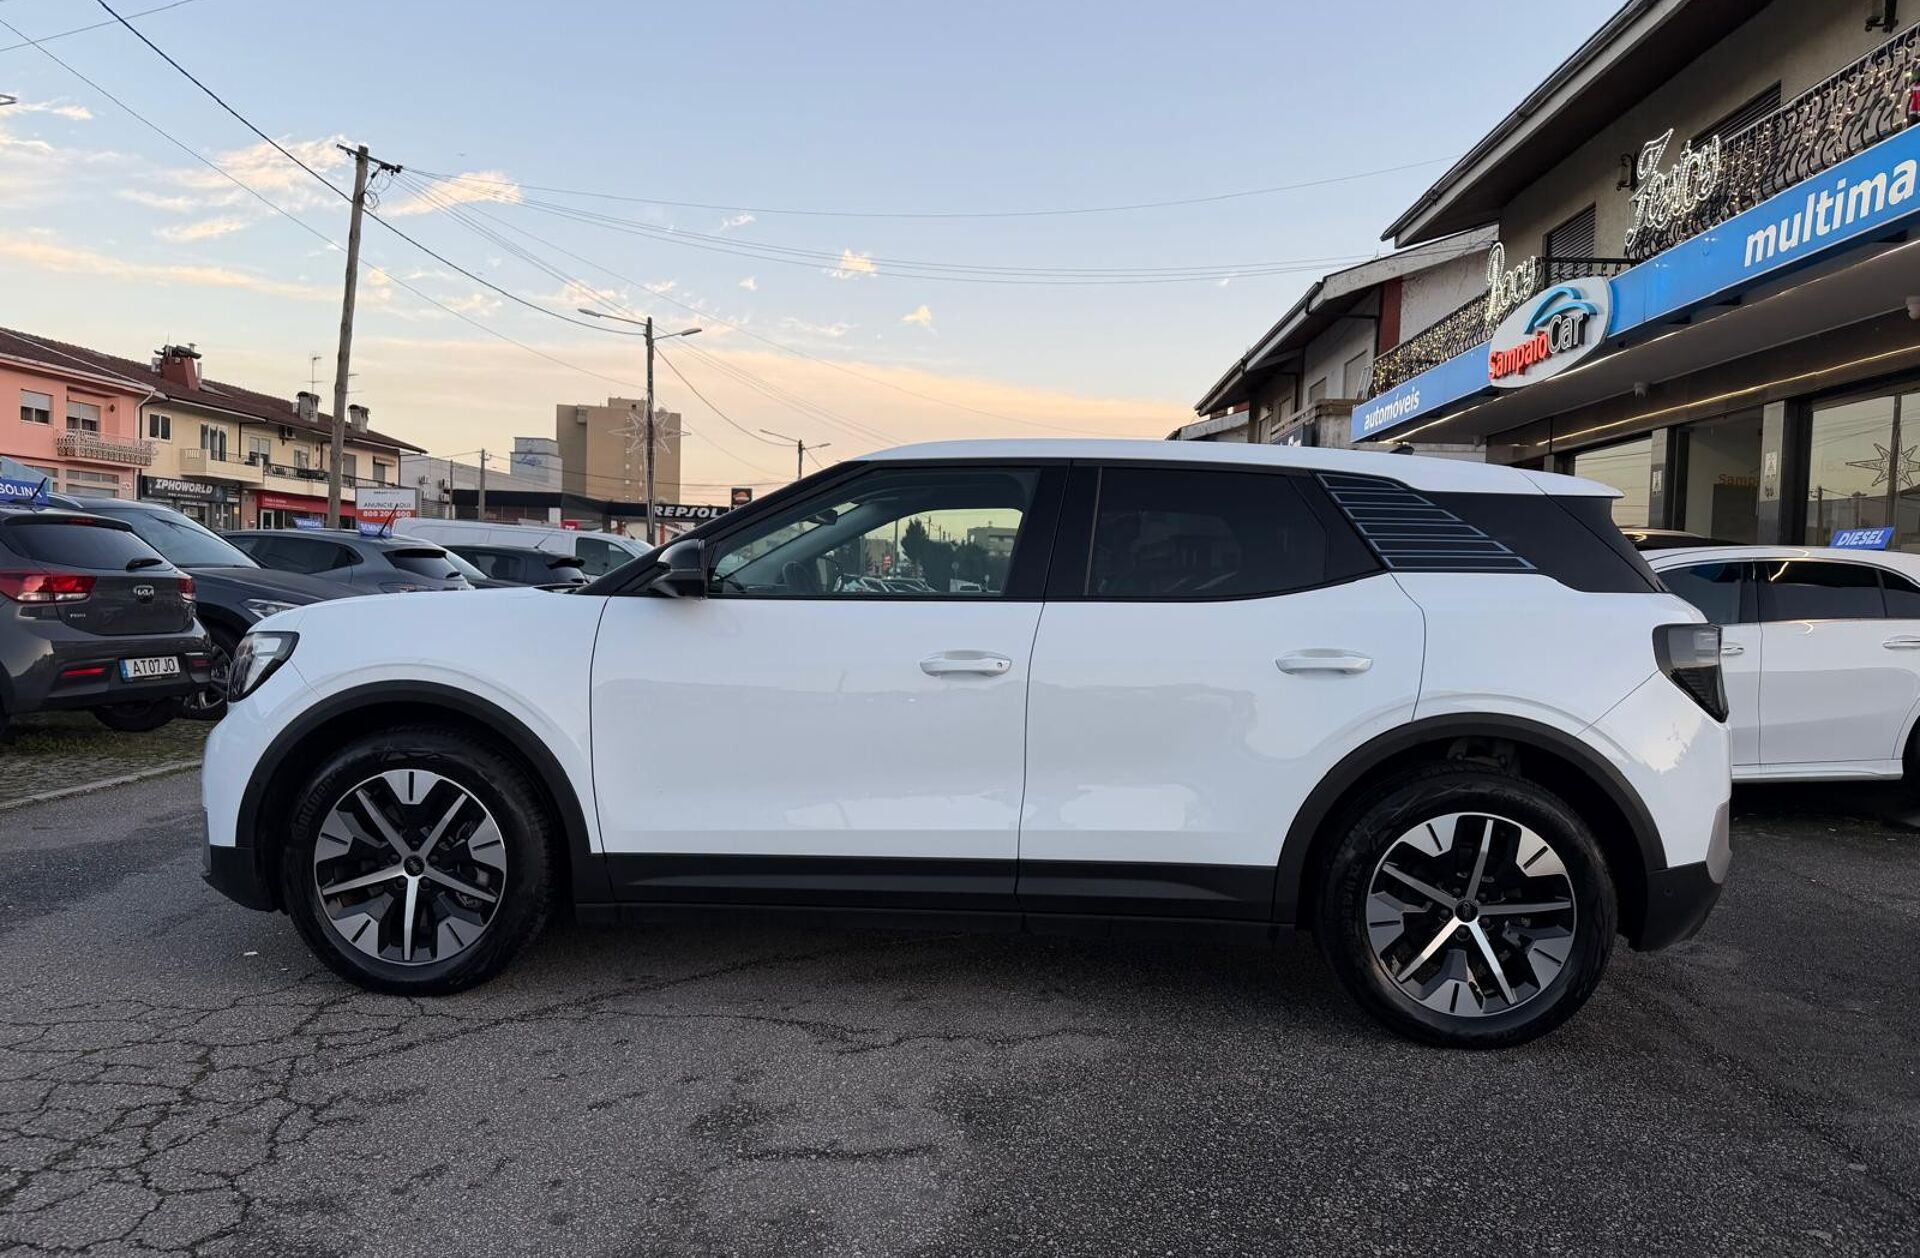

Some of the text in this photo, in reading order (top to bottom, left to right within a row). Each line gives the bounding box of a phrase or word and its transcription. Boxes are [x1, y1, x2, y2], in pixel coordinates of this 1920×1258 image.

[1744, 159, 1920, 268] multima
[1363, 386, 1420, 430] automóveis
[654, 506, 721, 519] REPSOL
[1836, 530, 1884, 546] DIESEL
